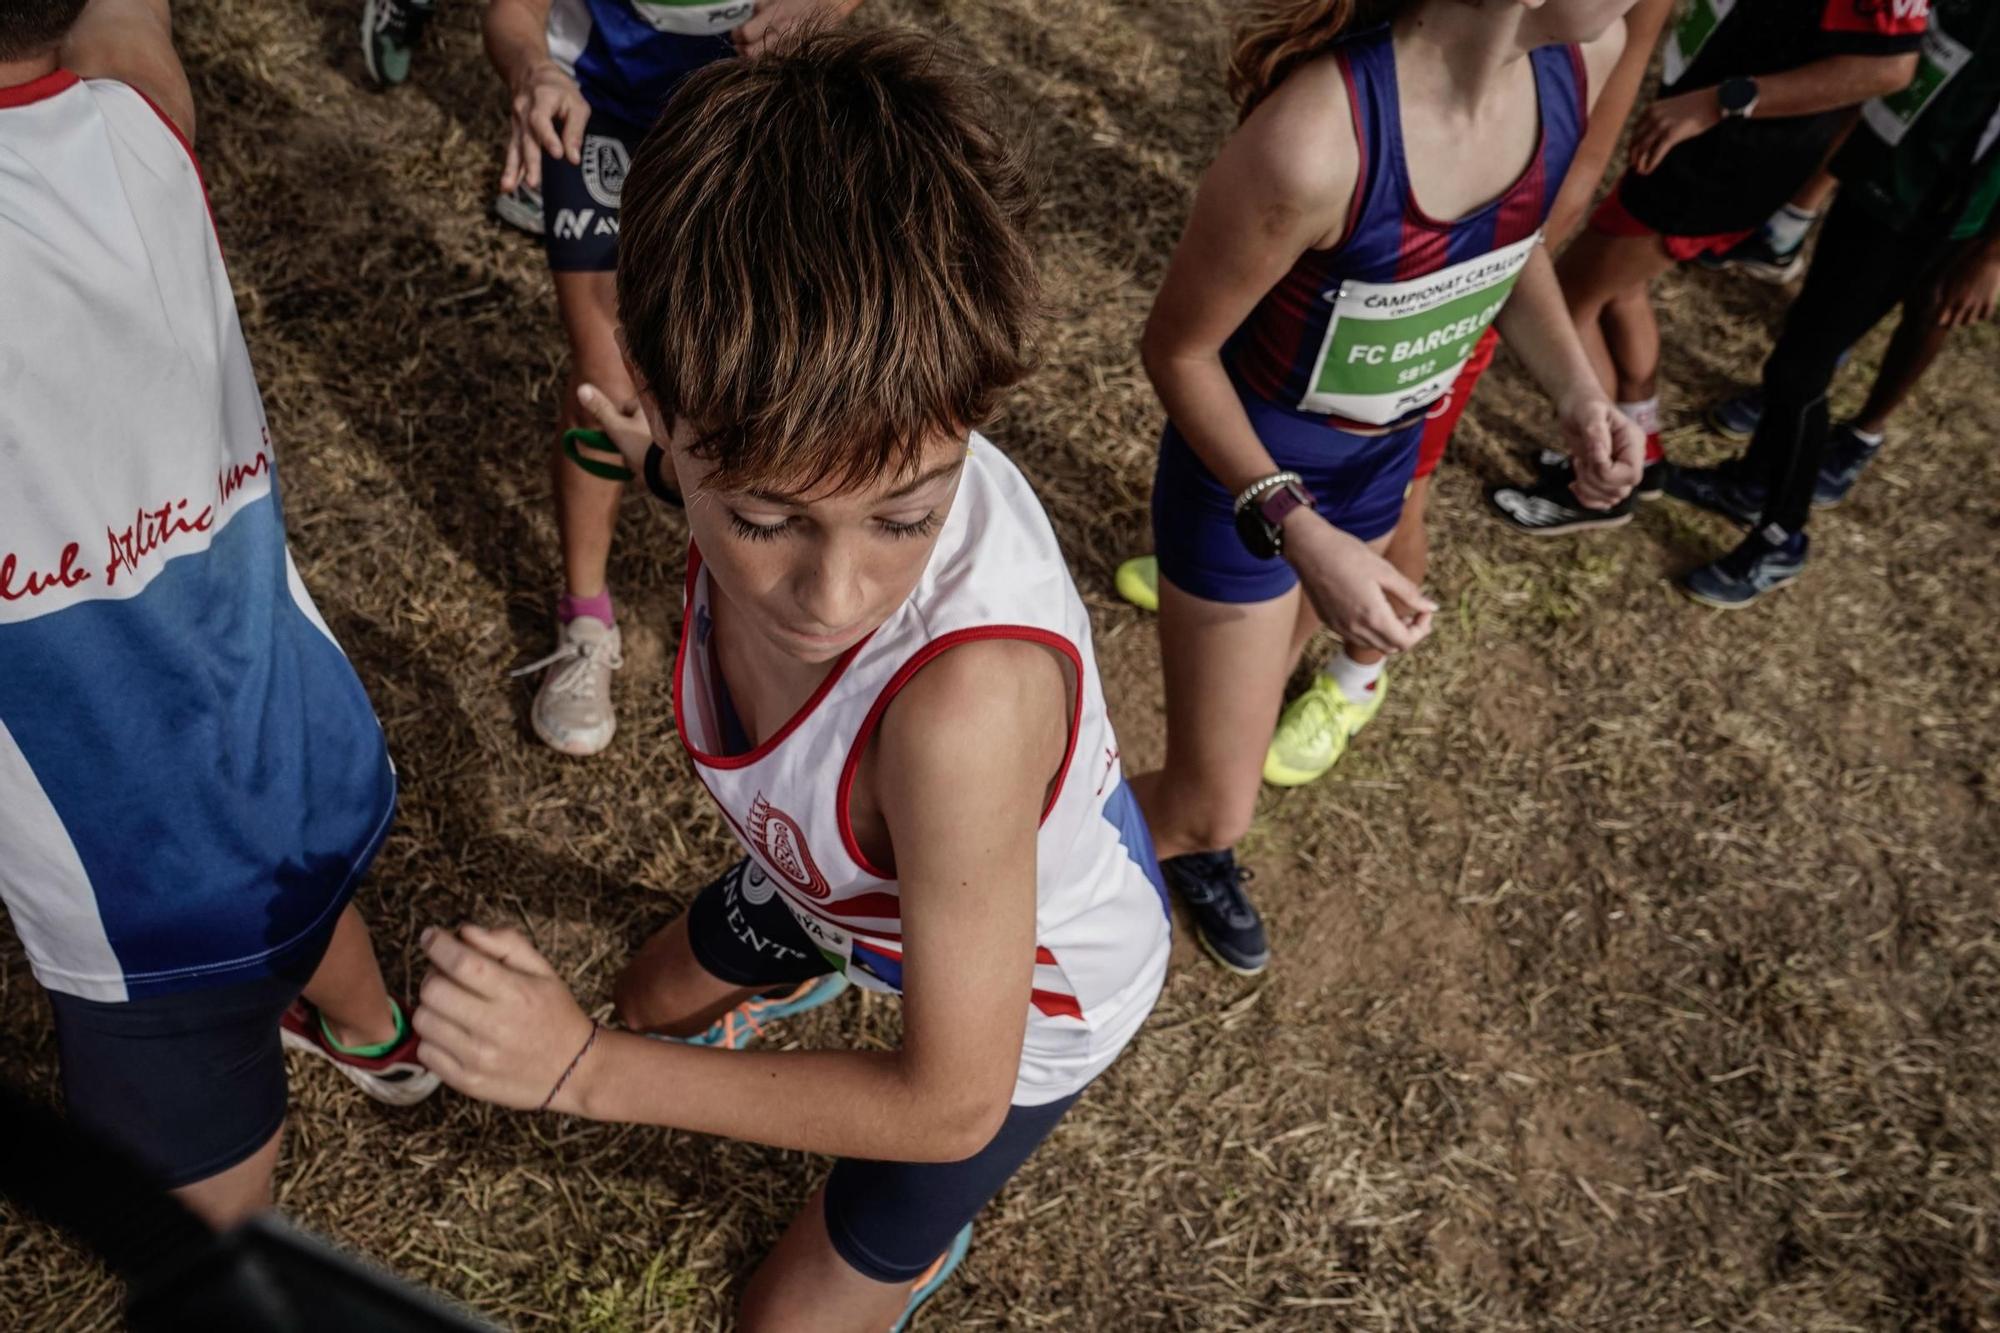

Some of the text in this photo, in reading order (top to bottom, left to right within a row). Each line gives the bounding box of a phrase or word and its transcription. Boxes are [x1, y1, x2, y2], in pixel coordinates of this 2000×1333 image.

[1364, 276, 1463, 308] CAMPIONAT
[1347, 345, 1384, 365] FC
[0, 542, 91, 600] lub
